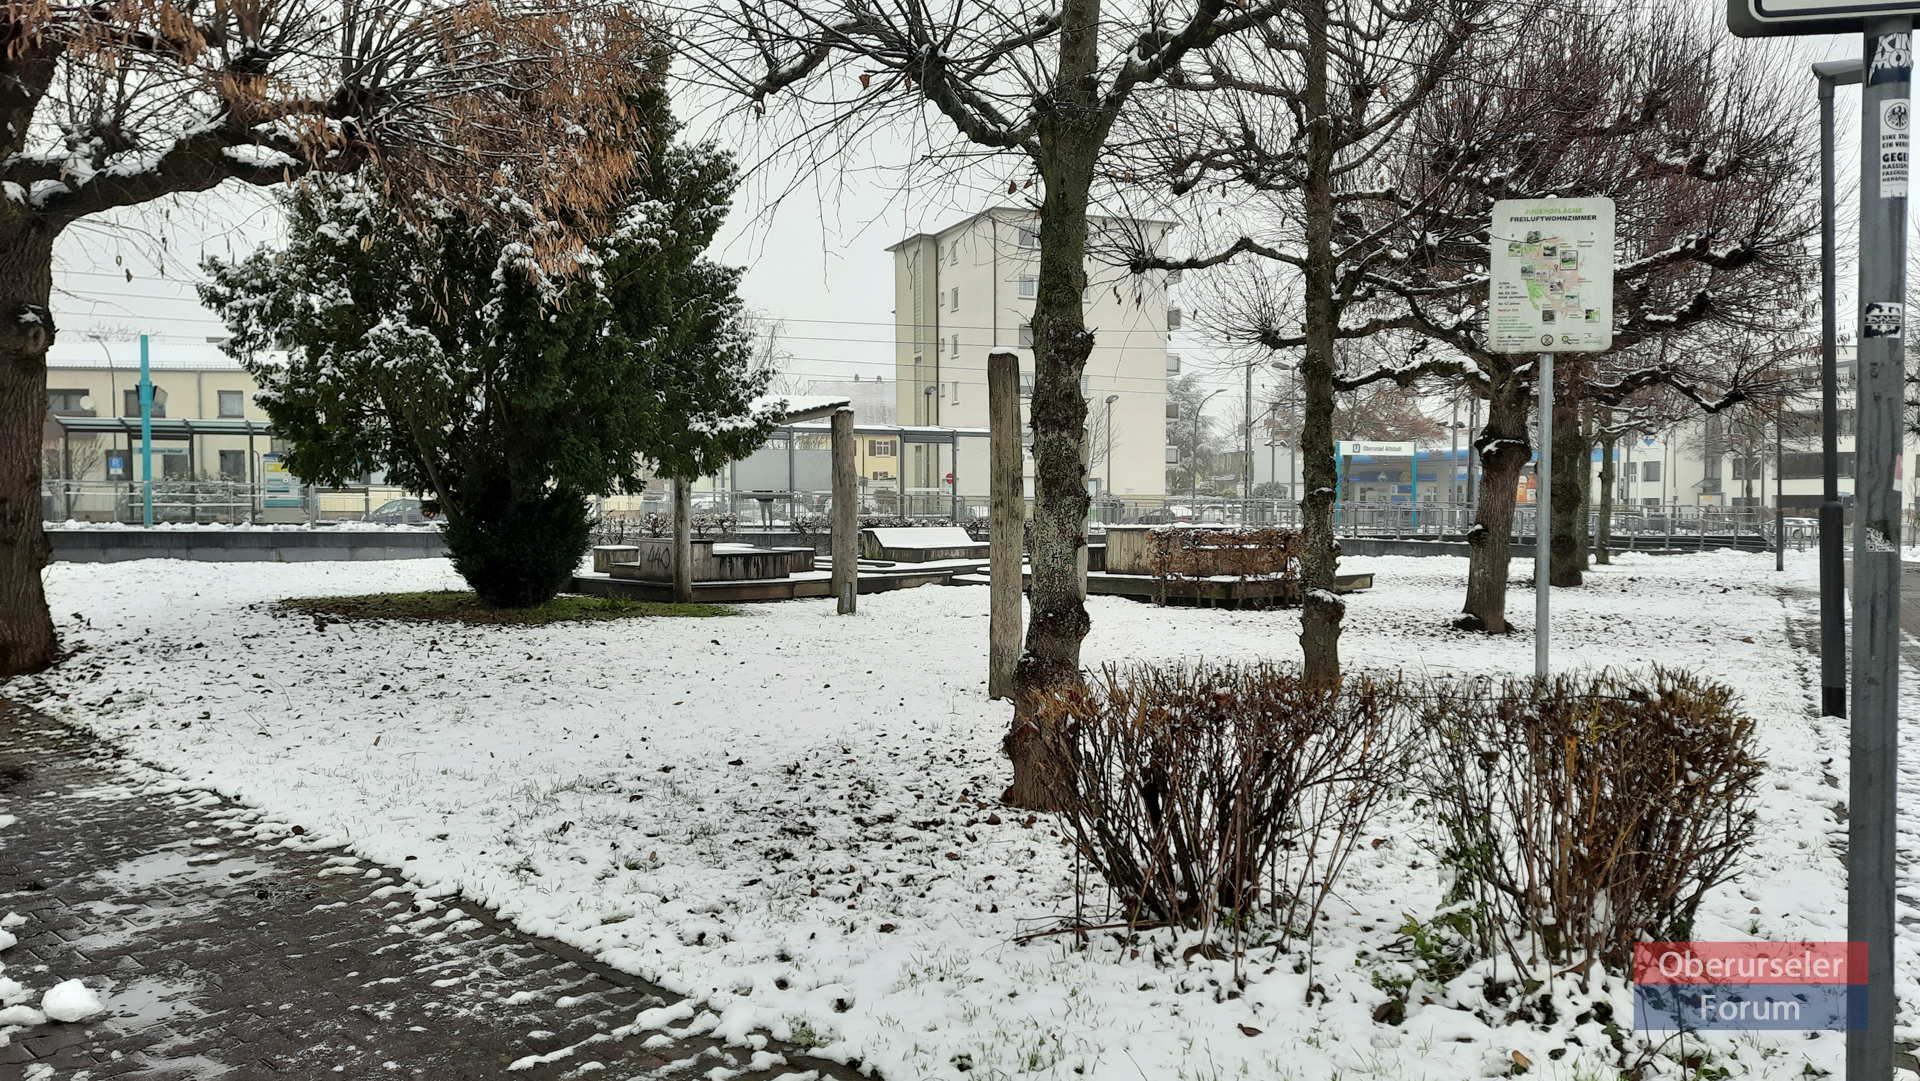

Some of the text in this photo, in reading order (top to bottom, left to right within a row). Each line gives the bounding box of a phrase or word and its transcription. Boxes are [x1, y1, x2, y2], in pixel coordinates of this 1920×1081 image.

[1882, 152, 1908, 163] GEGE
[1509, 214, 1597, 223] FREILUFTWOHNZIMMER
[647, 545, 671, 570] 440
